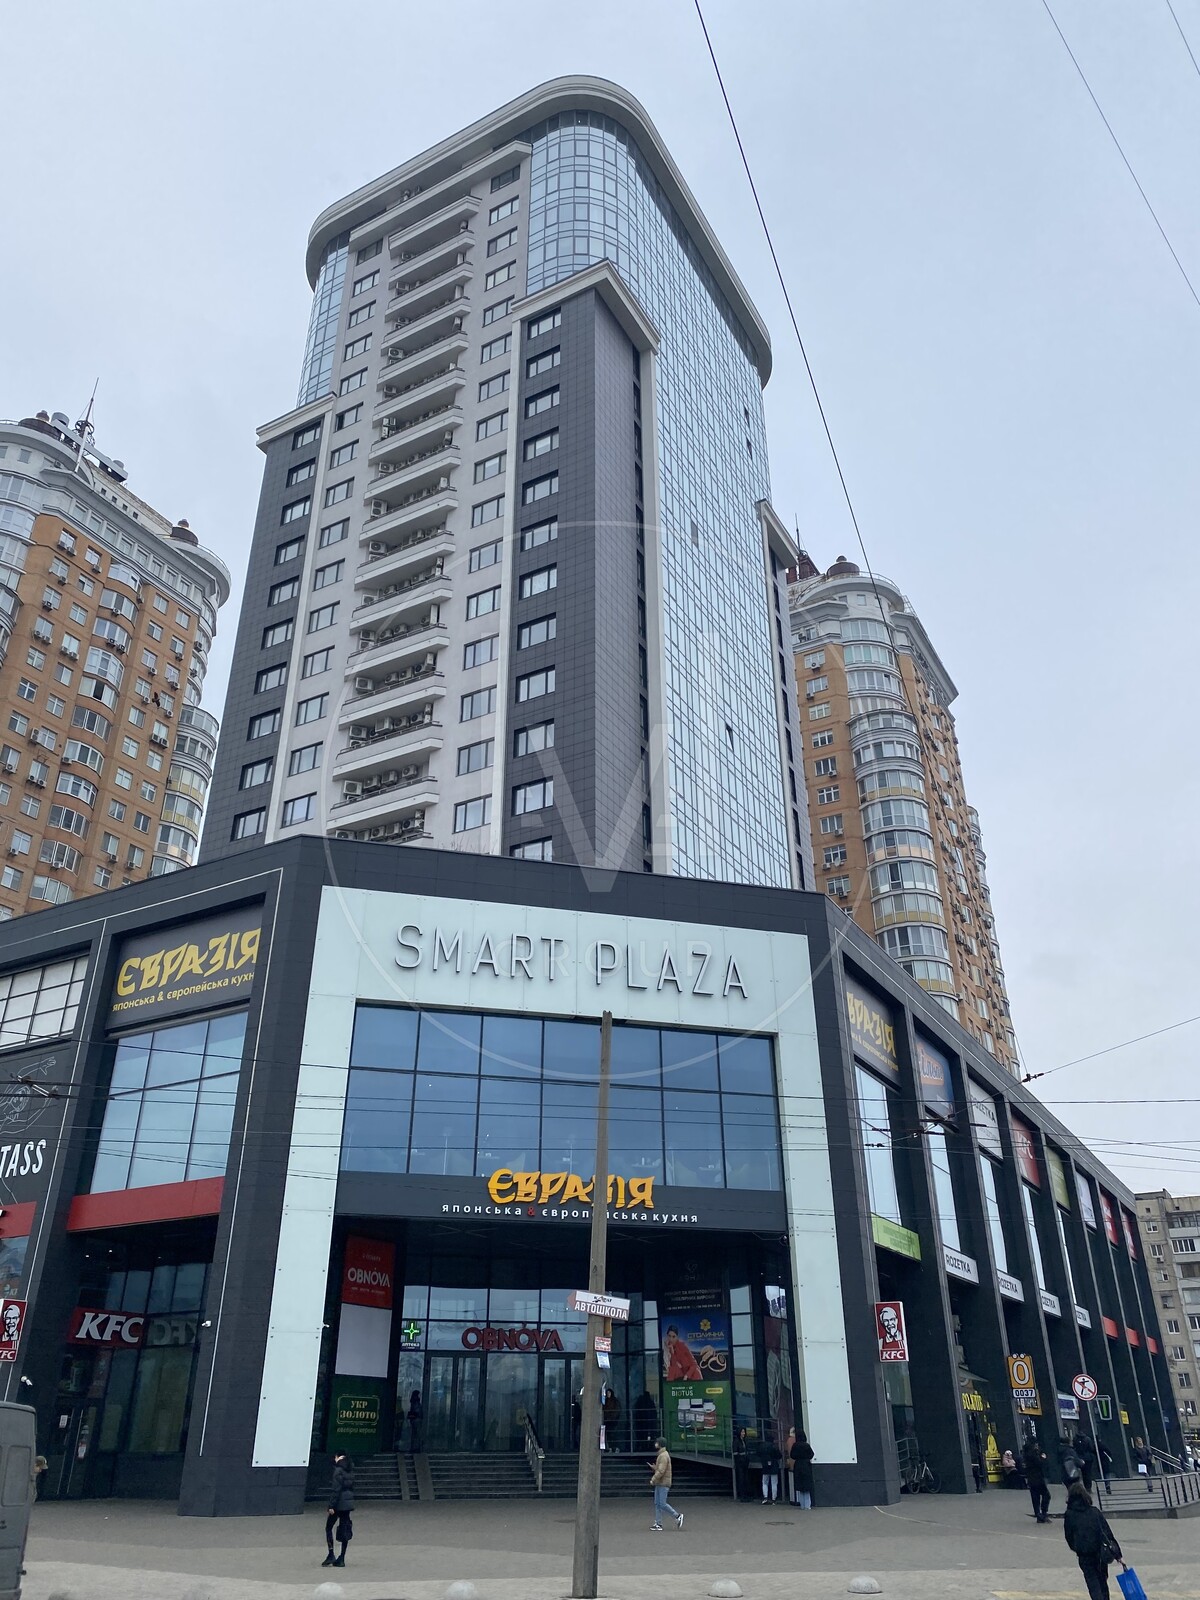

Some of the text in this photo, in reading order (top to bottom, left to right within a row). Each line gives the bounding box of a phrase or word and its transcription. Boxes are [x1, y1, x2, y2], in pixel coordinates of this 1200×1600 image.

[117, 927, 262, 997] ЄВРАЗІЯ
[395, 924, 749, 999] SMART PLAZA
[112, 971, 255, 1012] японська & європейська кухн
[847, 991, 896, 1058] ВРАЗІЯ
[441, 1203, 522, 1216] японська
[527, 1206, 535, 1217] &
[652, 1213, 698, 1224] кухня
[574, 1301, 627, 1319] АВТОШКОЛА
[75, 1312, 145, 1343] KFC
[881, 1350, 904, 1360] KFC
[1014, 1389, 1034, 1397] 0037
[339, 1410, 376, 1420] ЗОЛОТО
[350, 1400, 368, 1409] УКР
